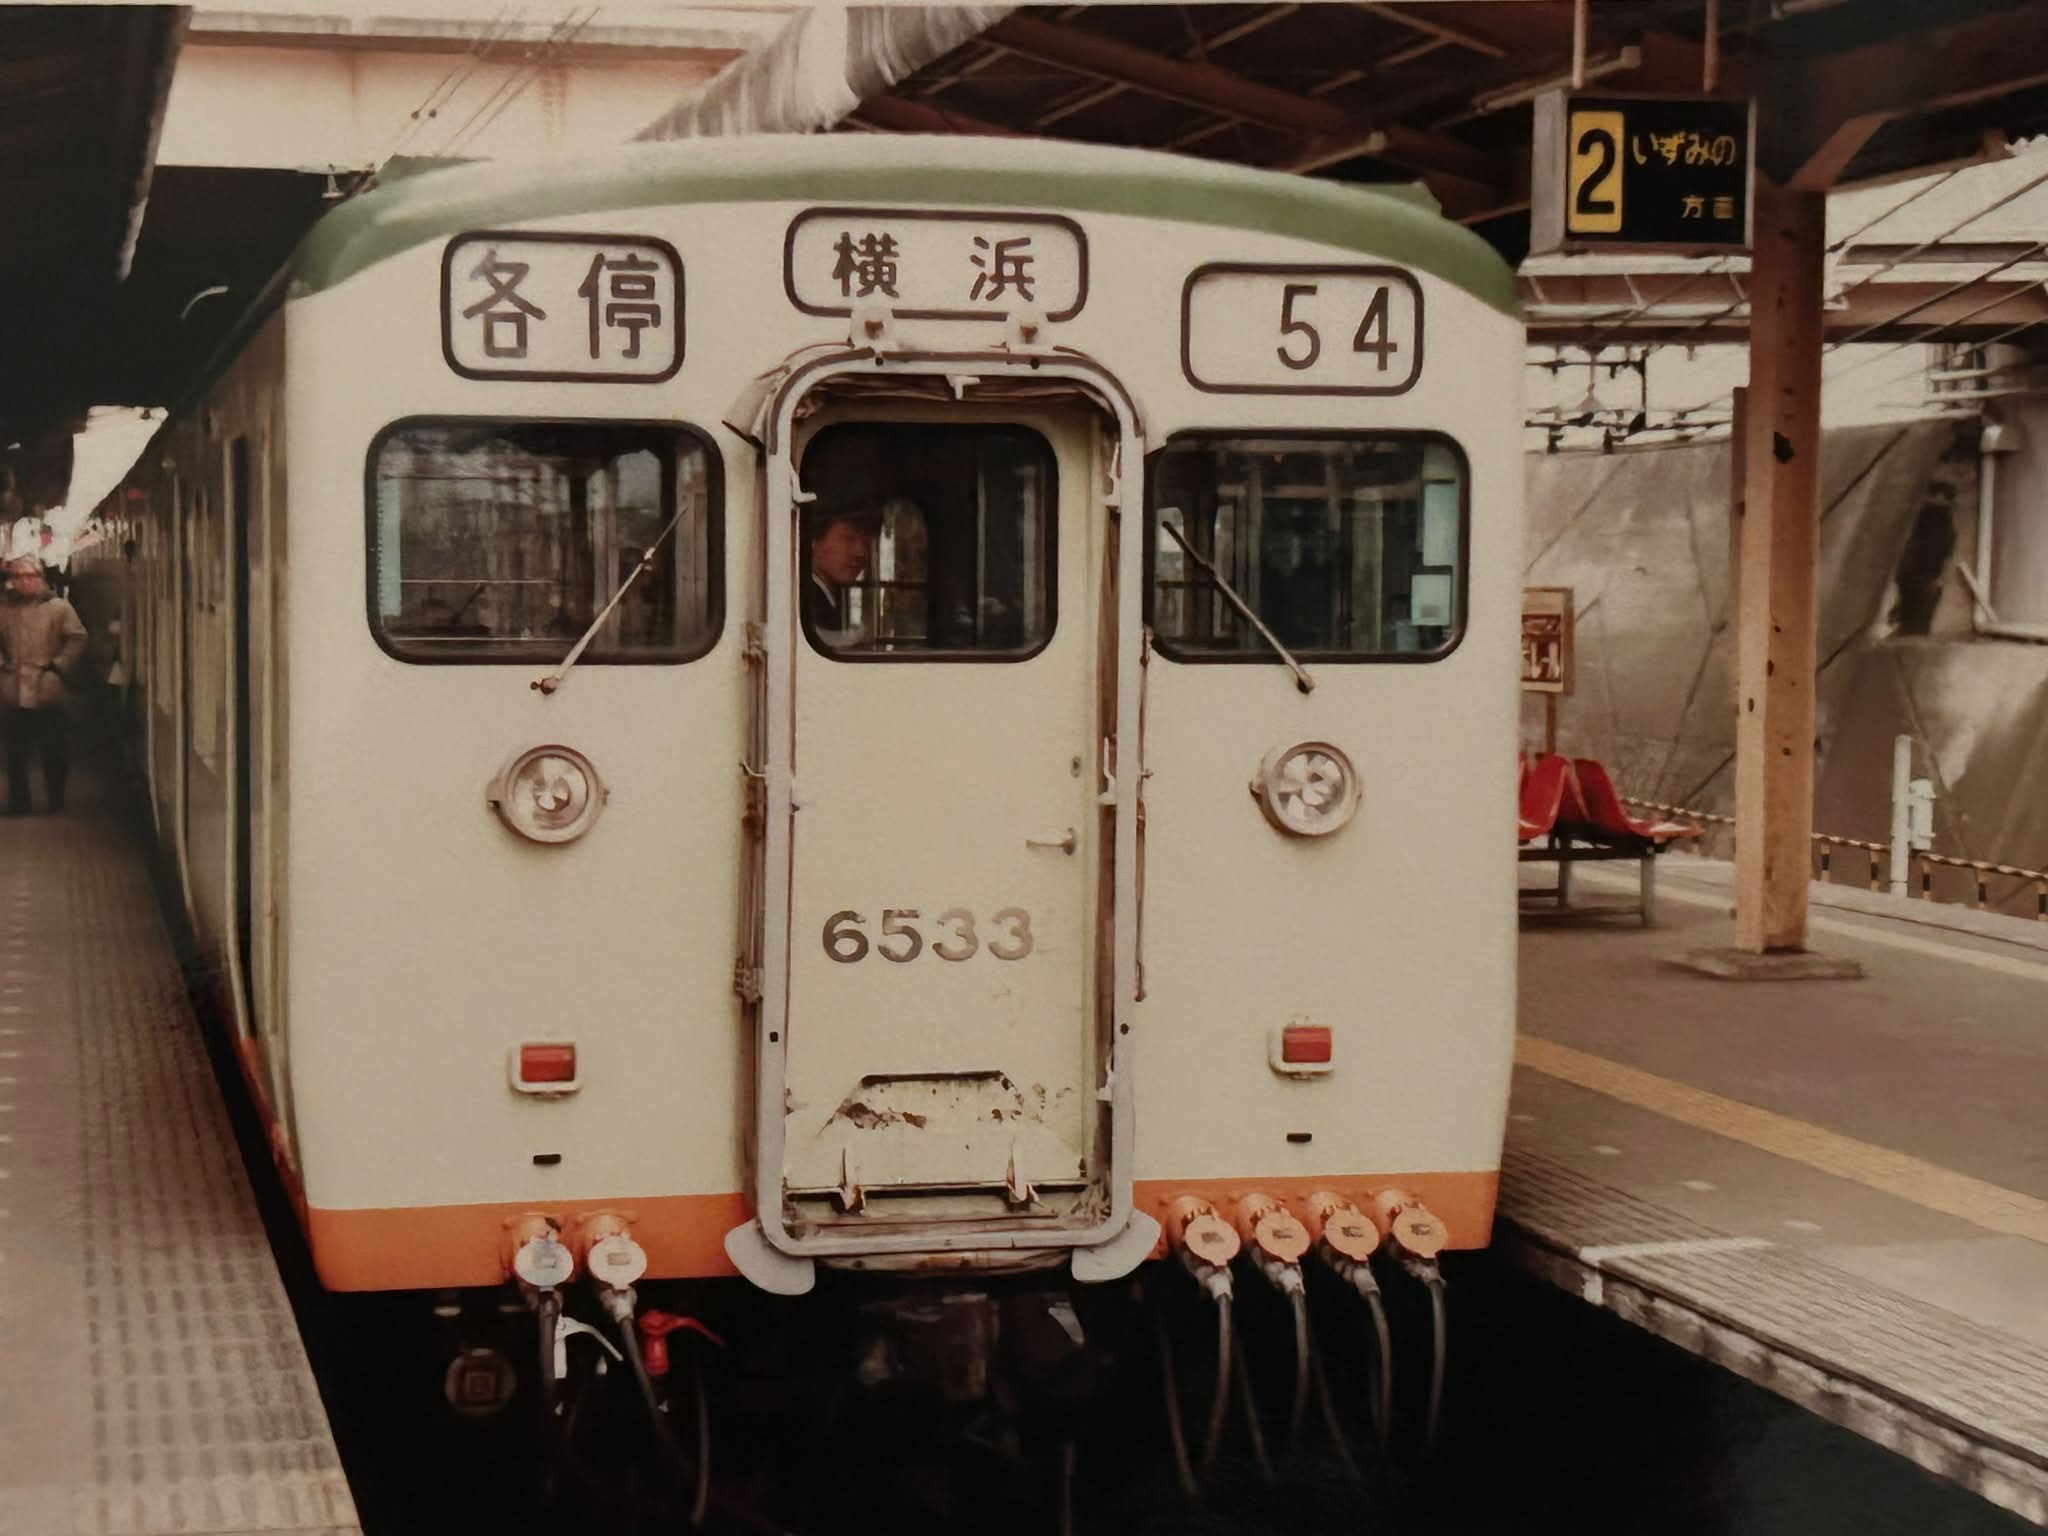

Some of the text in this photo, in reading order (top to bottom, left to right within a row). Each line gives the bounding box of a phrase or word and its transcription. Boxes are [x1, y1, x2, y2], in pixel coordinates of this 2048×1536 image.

[1576, 128, 1616, 215] 2
[1632, 130, 1736, 166] いずみの
[462, 248, 661, 360] 各停
[832, 231, 1036, 302] 横浜
[1276, 283, 1398, 371] 54
[822, 906, 1034, 963] 6533
